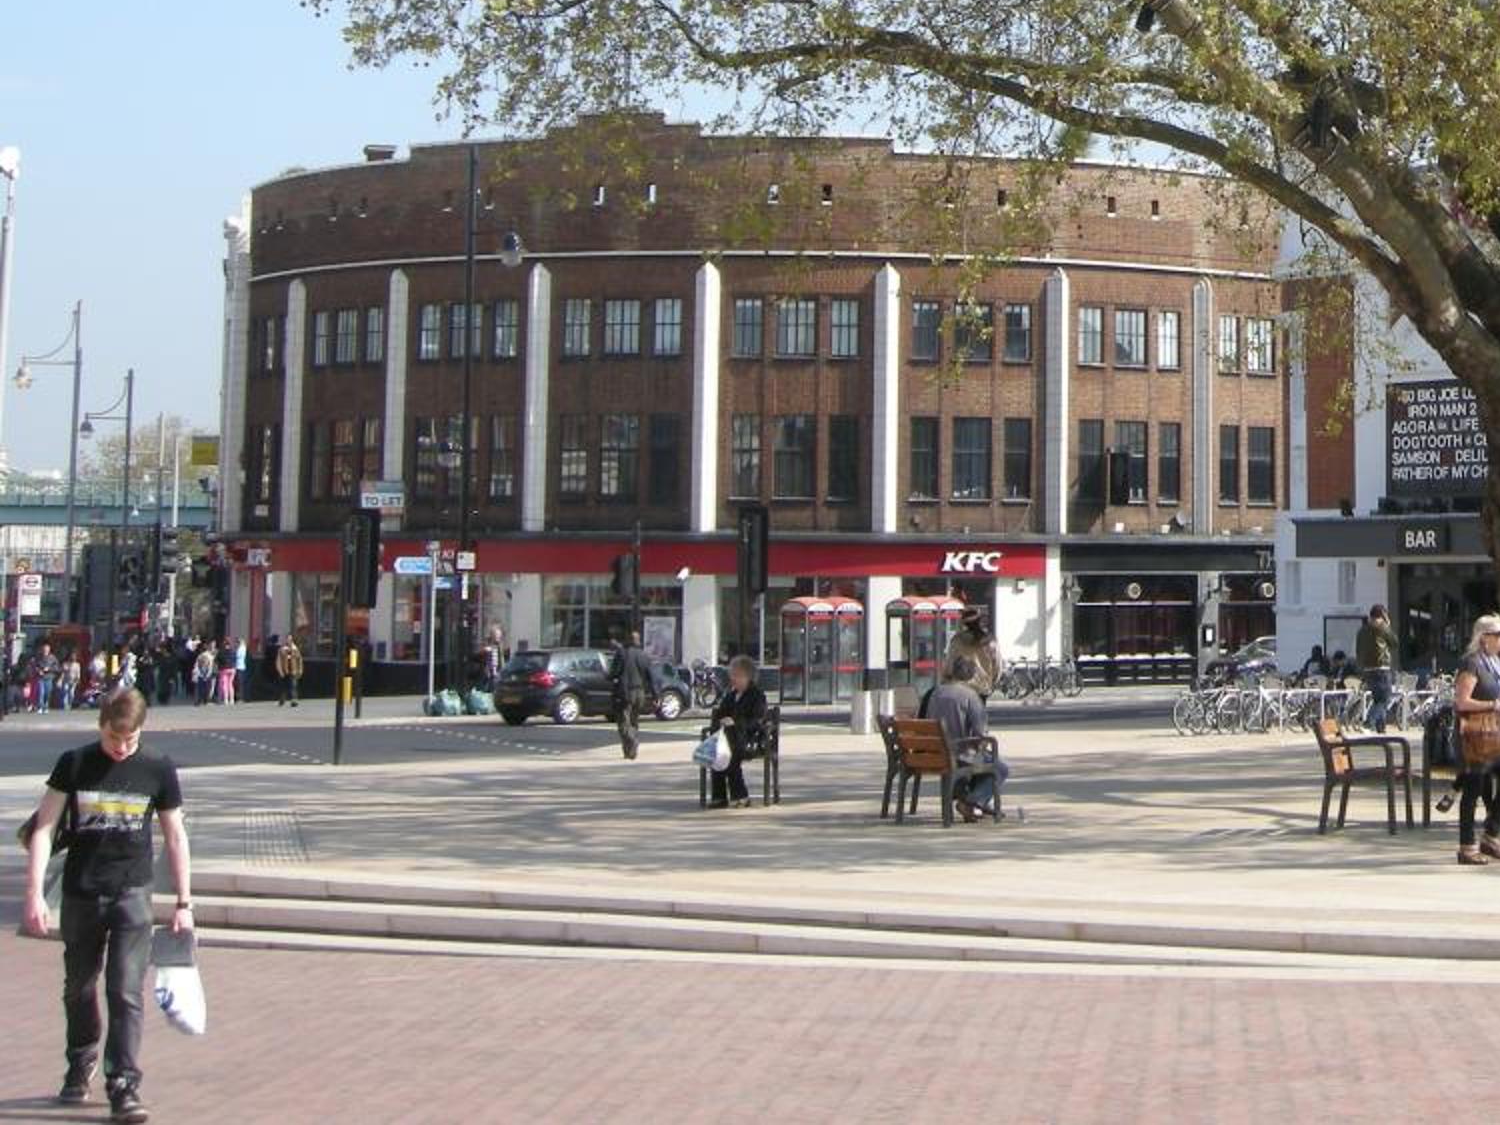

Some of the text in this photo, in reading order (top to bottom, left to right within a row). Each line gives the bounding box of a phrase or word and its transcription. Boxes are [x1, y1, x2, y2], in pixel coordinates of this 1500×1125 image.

[1417, 388, 1436, 402] BIG
[1438, 387, 1459, 401] JOE
[1408, 402, 1477, 418] IRON MAN 2
[1392, 420, 1436, 434] AGORA
[1452, 418, 1479, 431] LIFE
[1393, 434, 1462, 450] DOGTOOTH
[1392, 450, 1441, 466] SAMSON
[1392, 466, 1432, 480] FATHER
[1434, 466, 1449, 479] OF
[1452, 465, 1468, 479] MY
[365, 496, 401, 506] TO LET
[1405, 530, 1437, 548] BAR
[941, 551, 1003, 572] KFC
